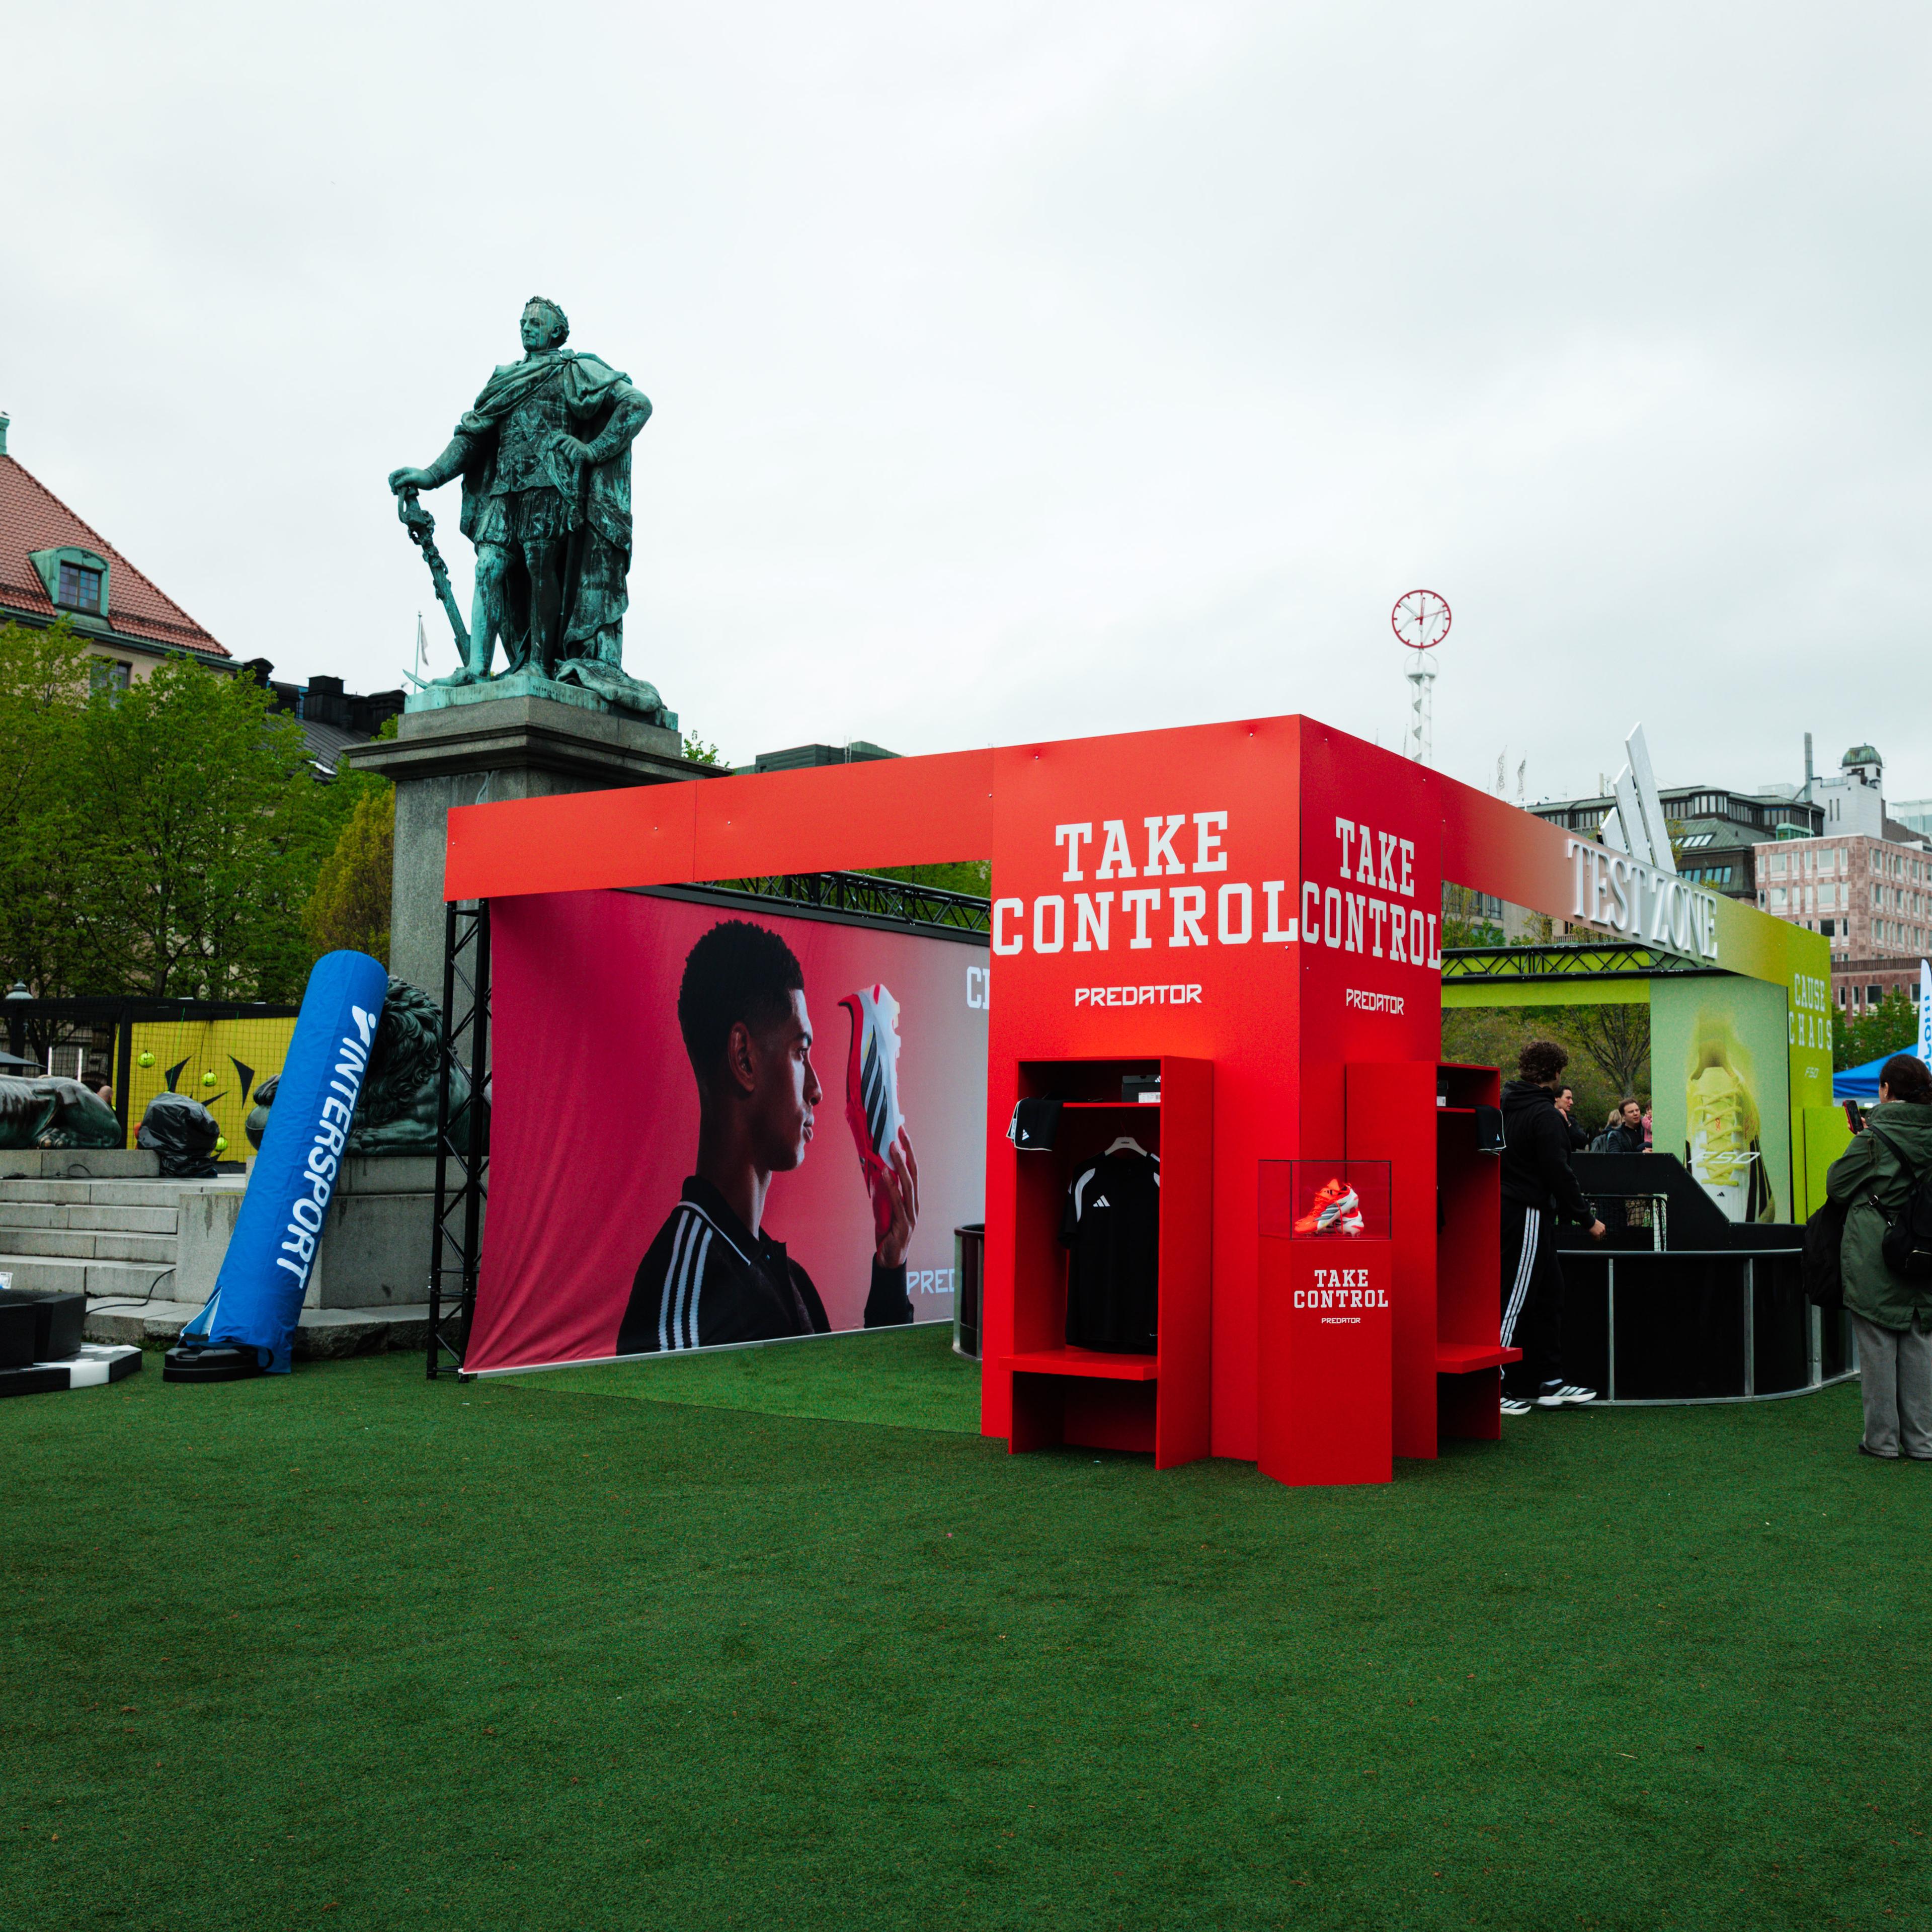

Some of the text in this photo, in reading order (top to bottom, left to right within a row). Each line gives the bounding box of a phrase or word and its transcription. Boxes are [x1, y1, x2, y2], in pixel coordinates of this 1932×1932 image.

[1056, 811, 1228, 882] TAKE
[1336, 816, 1414, 897] TAKE
[993, 880, 1298, 955] CONTROL
[1568, 839, 1718, 959] TEST ZONE
[1302, 880, 1441, 970] CONTROL
[1075, 984, 1202, 1006] PREDATOR
[1346, 988, 1404, 1015] PREDATOR
[1795, 973, 1825, 1012] CAUSE
[1789, 1011, 1832, 1051] CHAOS
[277, 1036, 367, 1289] INTERSPORT
[1688, 1151, 1760, 1164] F50
[1314, 1269, 1368, 1287] TAKE
[1294, 1290, 1388, 1308] CONTROL
